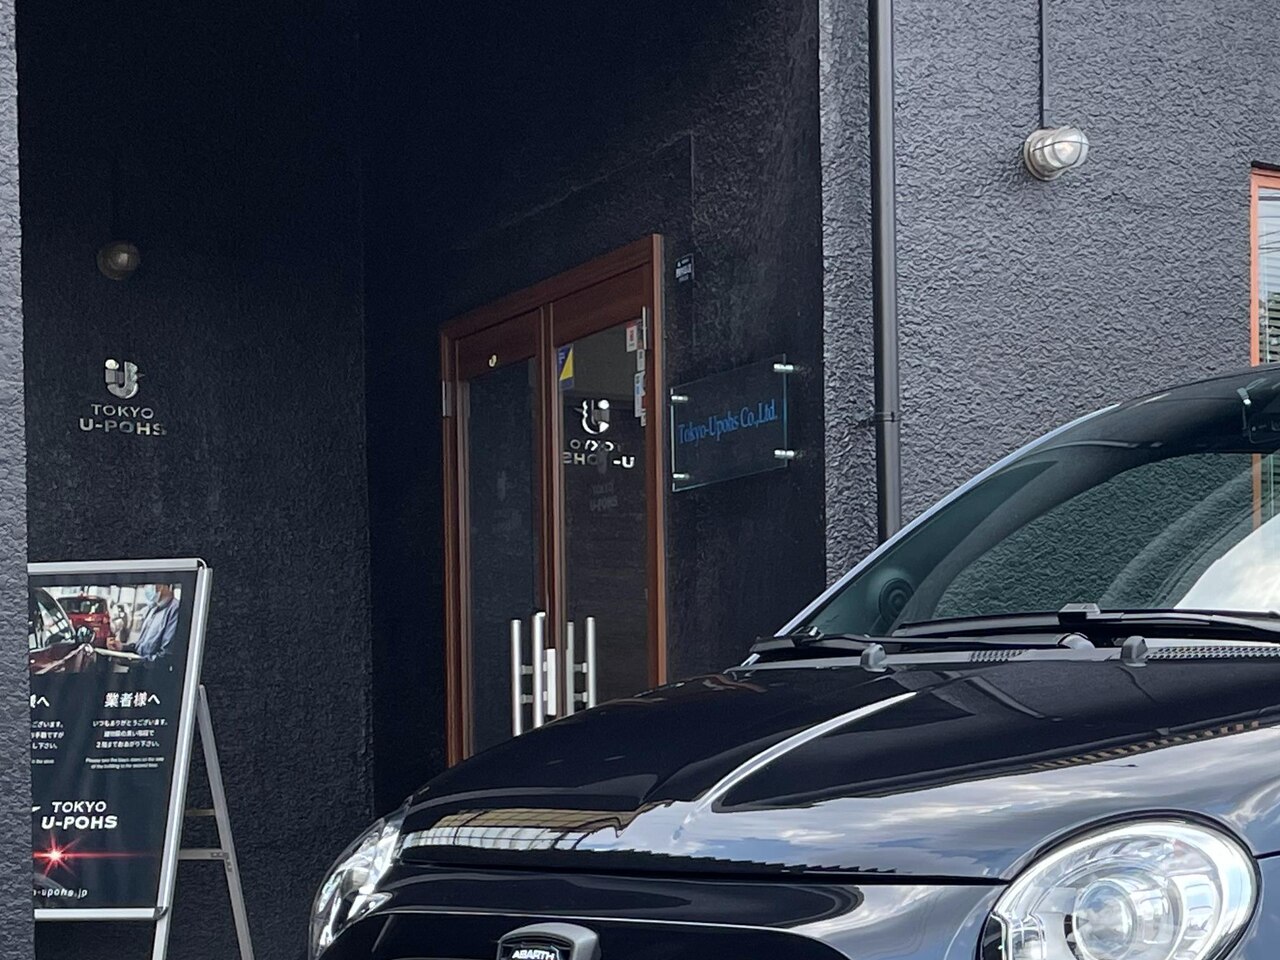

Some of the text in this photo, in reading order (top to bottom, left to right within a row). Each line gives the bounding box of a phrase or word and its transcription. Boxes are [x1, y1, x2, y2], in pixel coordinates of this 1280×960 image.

[91, 404, 154, 419] TOKYO
[80, 418, 167, 435] U-POHS
[104, 691, 160, 708] 業者様へ
[52, 801, 107, 813] TOKYO
[41, 815, 118, 829] U-POHS
[512, 949, 555, 960] ABARTH
